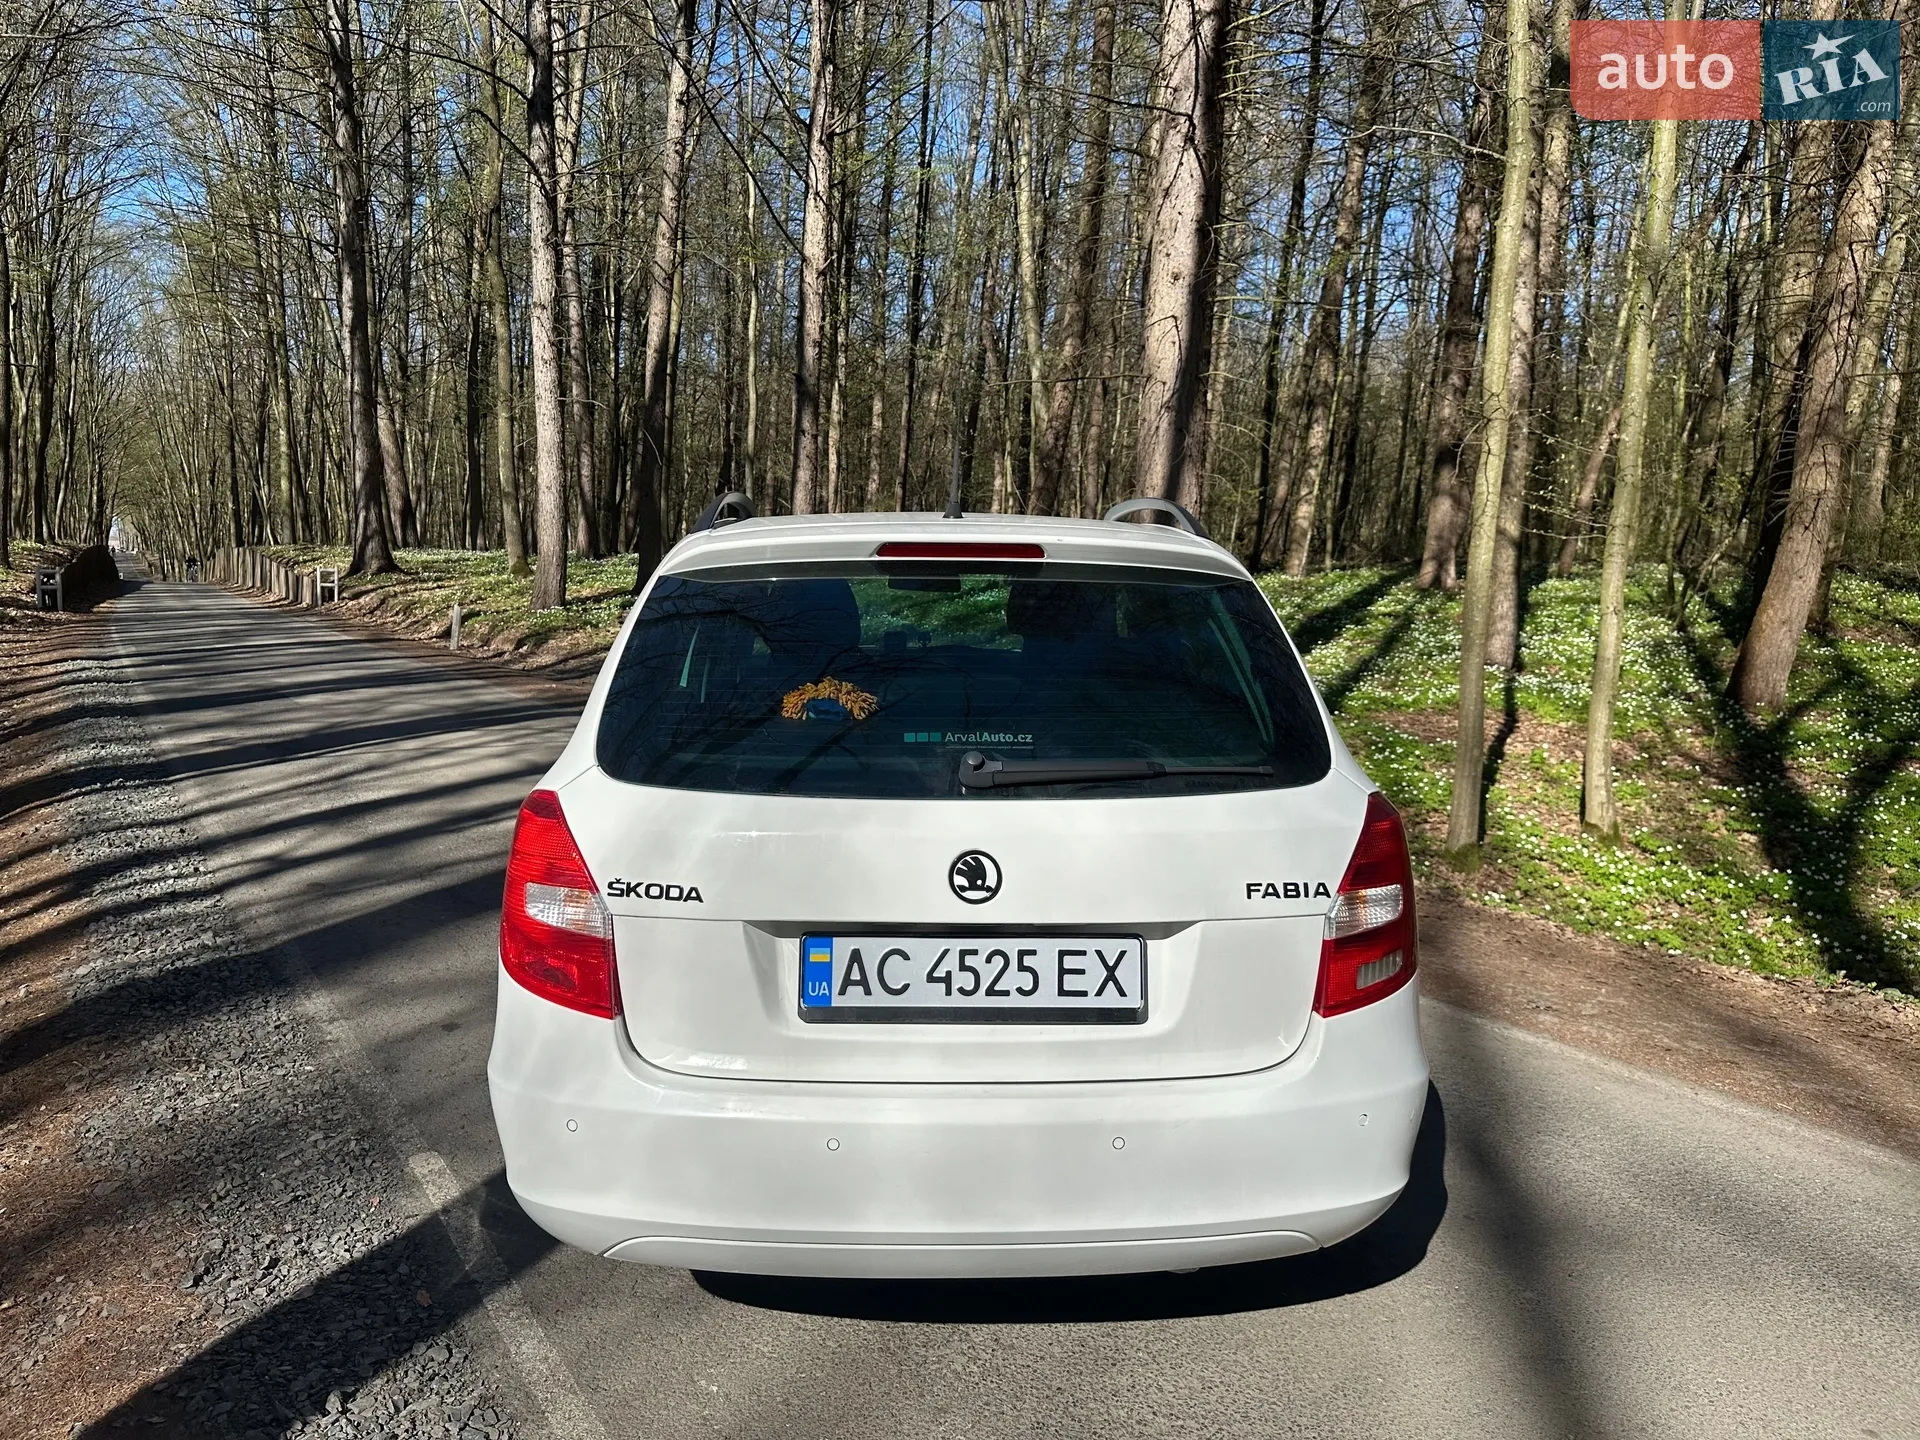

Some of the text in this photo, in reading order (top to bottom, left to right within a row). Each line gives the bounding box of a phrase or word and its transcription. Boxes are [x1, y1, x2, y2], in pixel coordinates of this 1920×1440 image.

[944, 732, 1033, 743] ArvalAuto.cz
[607, 877, 704, 903] ŠKODA
[1246, 882, 1332, 900] FABIA
[837, 947, 1128, 998] AC 4525 EX
[808, 981, 830, 997] UA
